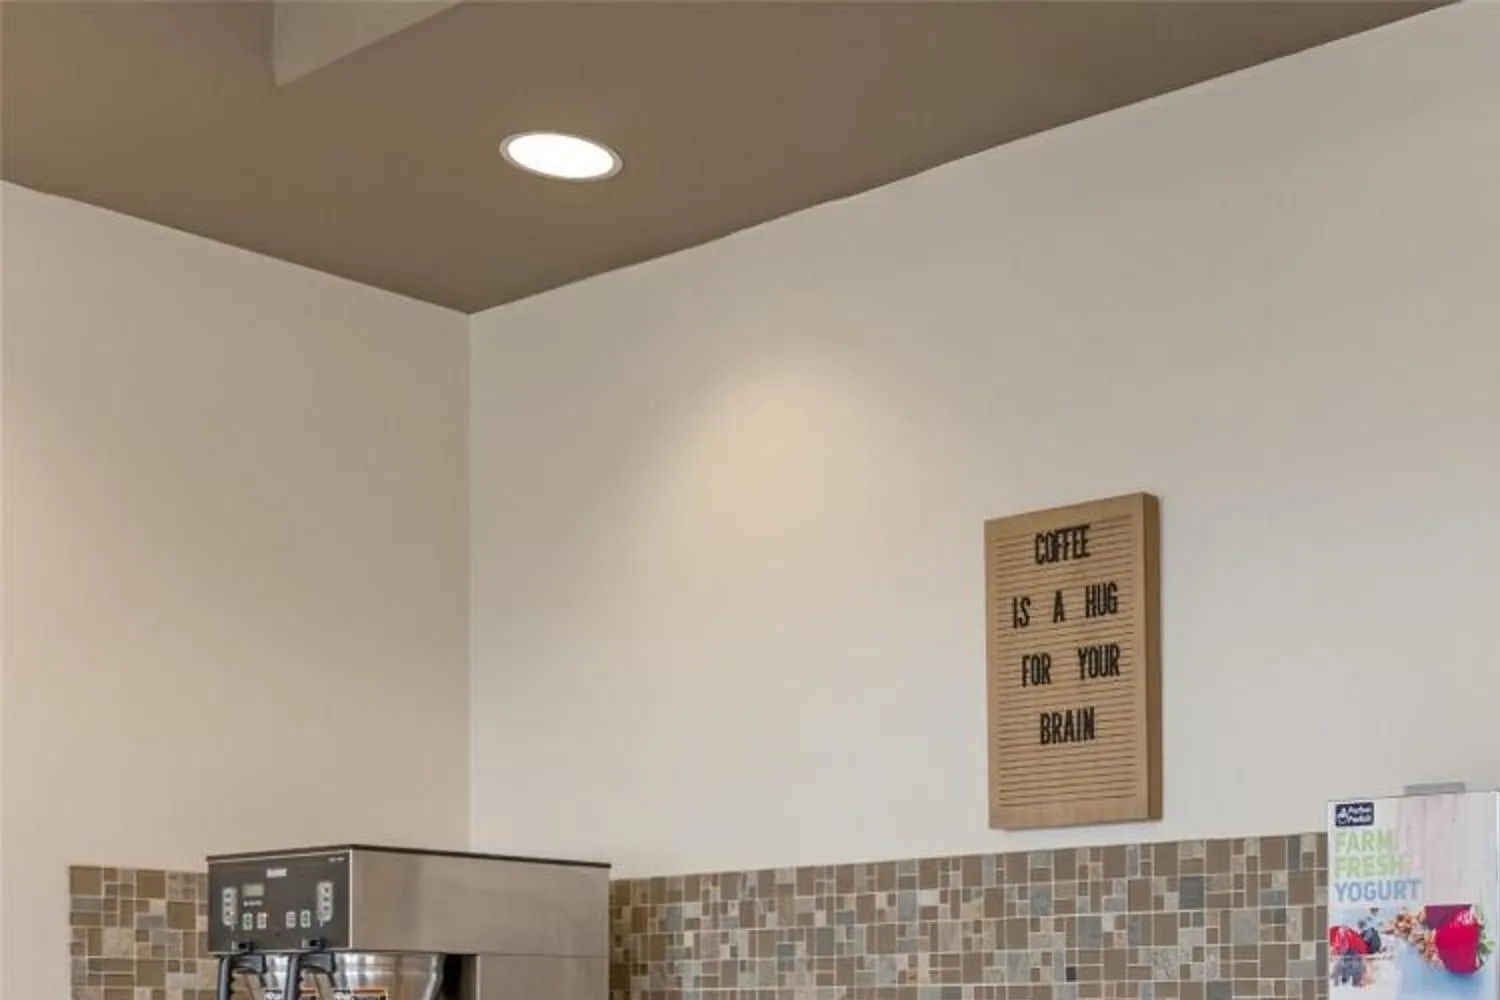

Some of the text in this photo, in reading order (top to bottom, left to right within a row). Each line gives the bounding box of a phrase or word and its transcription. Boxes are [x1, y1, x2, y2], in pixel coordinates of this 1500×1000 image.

[1034, 523, 1092, 565] COFFEE
[1012, 580, 1118, 629] IS A HUG
[1020, 642, 1120, 688] FOR YOUR
[1039, 705, 1095, 745] BRAIN
[1334, 829, 1399, 854] FARM
[1334, 853, 1405, 878] FRESH
[1333, 877, 1422, 902] YOGURT
